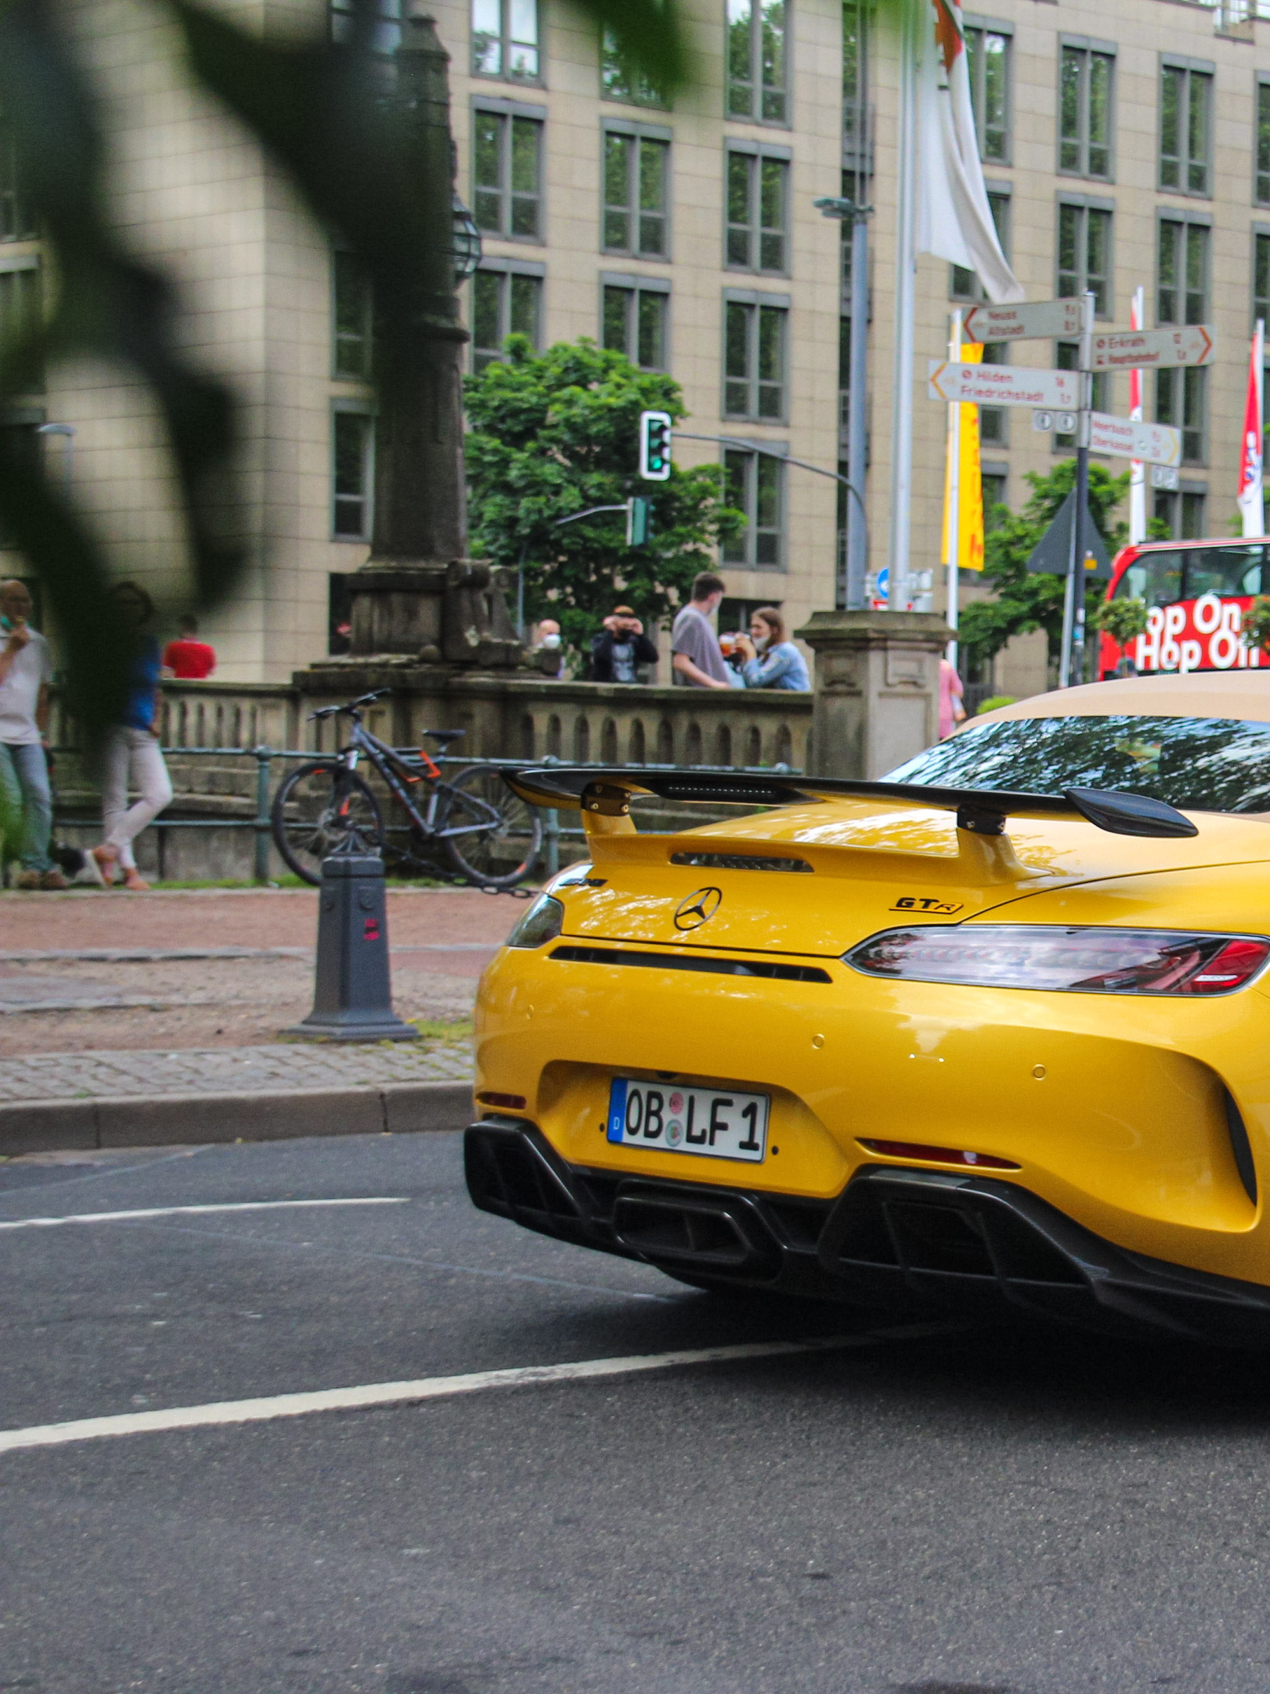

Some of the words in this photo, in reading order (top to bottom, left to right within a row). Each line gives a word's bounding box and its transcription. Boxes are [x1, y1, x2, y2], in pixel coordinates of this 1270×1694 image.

[988, 324, 1025, 337] Altstadt
[1109, 335, 1146, 349] Erkrath
[977, 371, 1013, 384] Hilden
[961, 384, 1044, 402] Friedrichstadt
[1146, 605, 1187, 641] op
[1193, 593, 1242, 634] On
[1136, 632, 1202, 674] Hop
[626, 1088, 665, 1140] OB
